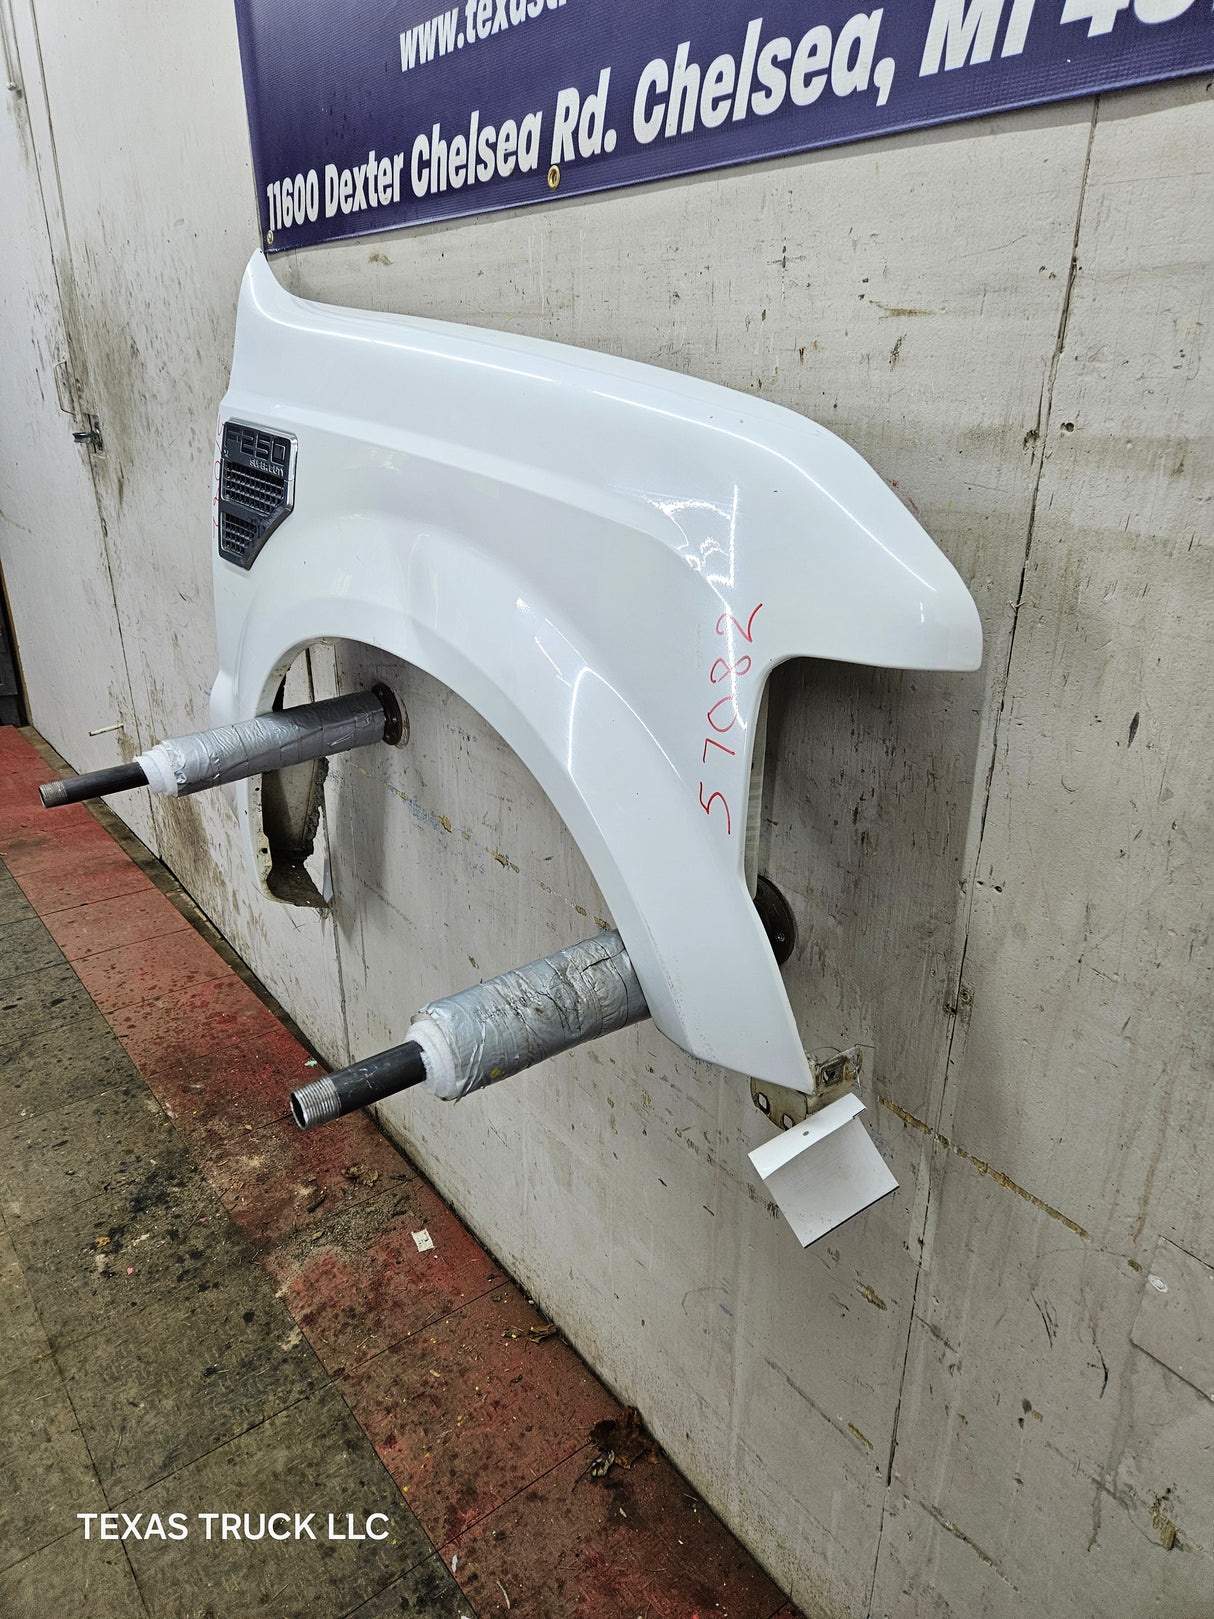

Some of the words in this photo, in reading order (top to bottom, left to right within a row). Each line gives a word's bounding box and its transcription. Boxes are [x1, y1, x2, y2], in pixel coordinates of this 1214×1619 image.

[266, 169, 319, 231] 11600
[325, 151, 404, 218] Dexter
[410, 110, 543, 197] Chelsea
[550, 67, 617, 165] Rd.
[632, 7, 896, 144] Chelsea,
[699, 603, 763, 835] 57082
